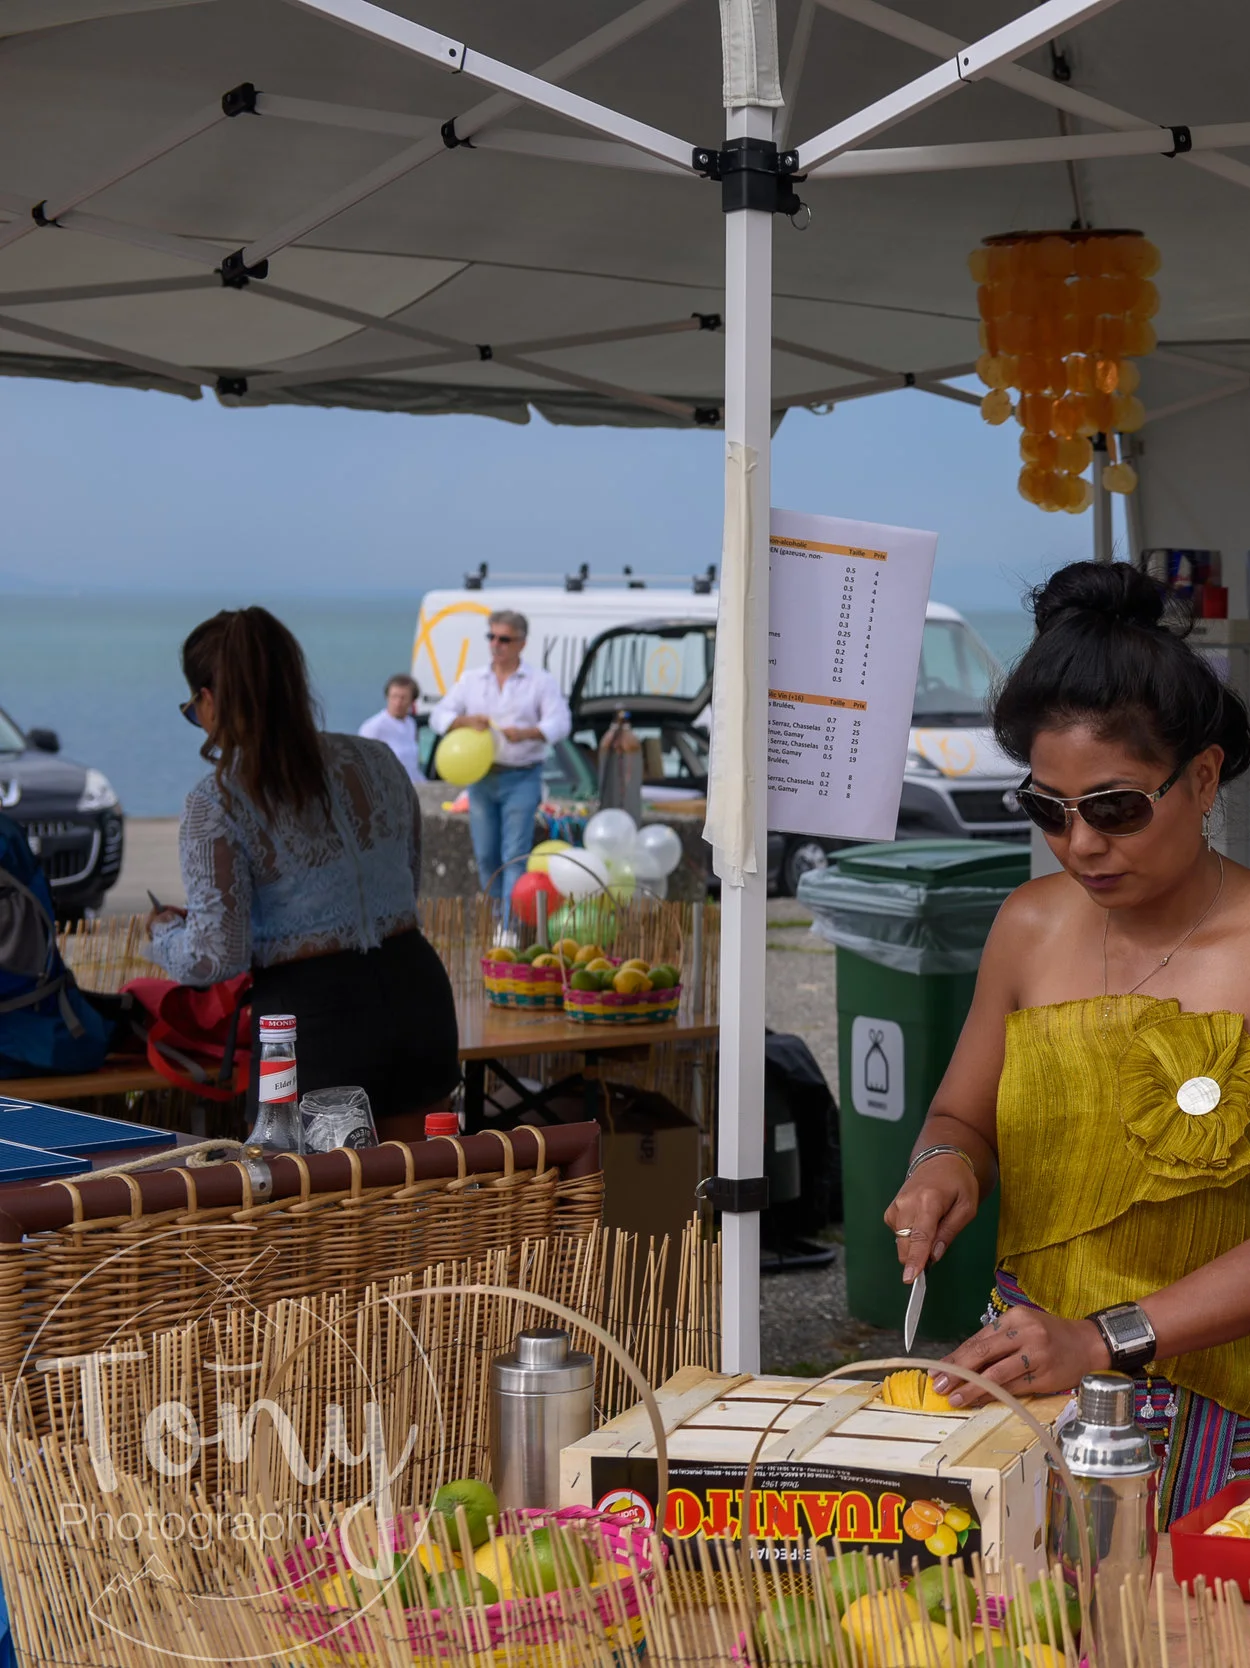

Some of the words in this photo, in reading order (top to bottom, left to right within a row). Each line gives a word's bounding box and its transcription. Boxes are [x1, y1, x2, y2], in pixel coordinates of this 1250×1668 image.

[779, 548, 807, 558] (gazeuse,
[849, 549, 865, 557] Taille
[837, 630, 851, 638] 0.25
[832, 675, 842, 683] 0.5
[830, 699, 845, 707] Taille
[772, 720, 791, 728] Serraz,
[792, 722, 821, 731] Chasselas
[783, 730, 804, 739] Gamay
[770, 738, 790, 746] Serraz,
[790, 740, 819, 749] Chasselas
[782, 749, 802, 757] Gamay
[786, 777, 814, 786] Chasselas
[777, 785, 799, 794] Gamay
[760, 1480, 779, 1488] 1967
[779, 1480, 800, 1489] Desde
[864, 1477, 901, 1488] HERMANOS
[657, 1488, 906, 1544] JUANITO
